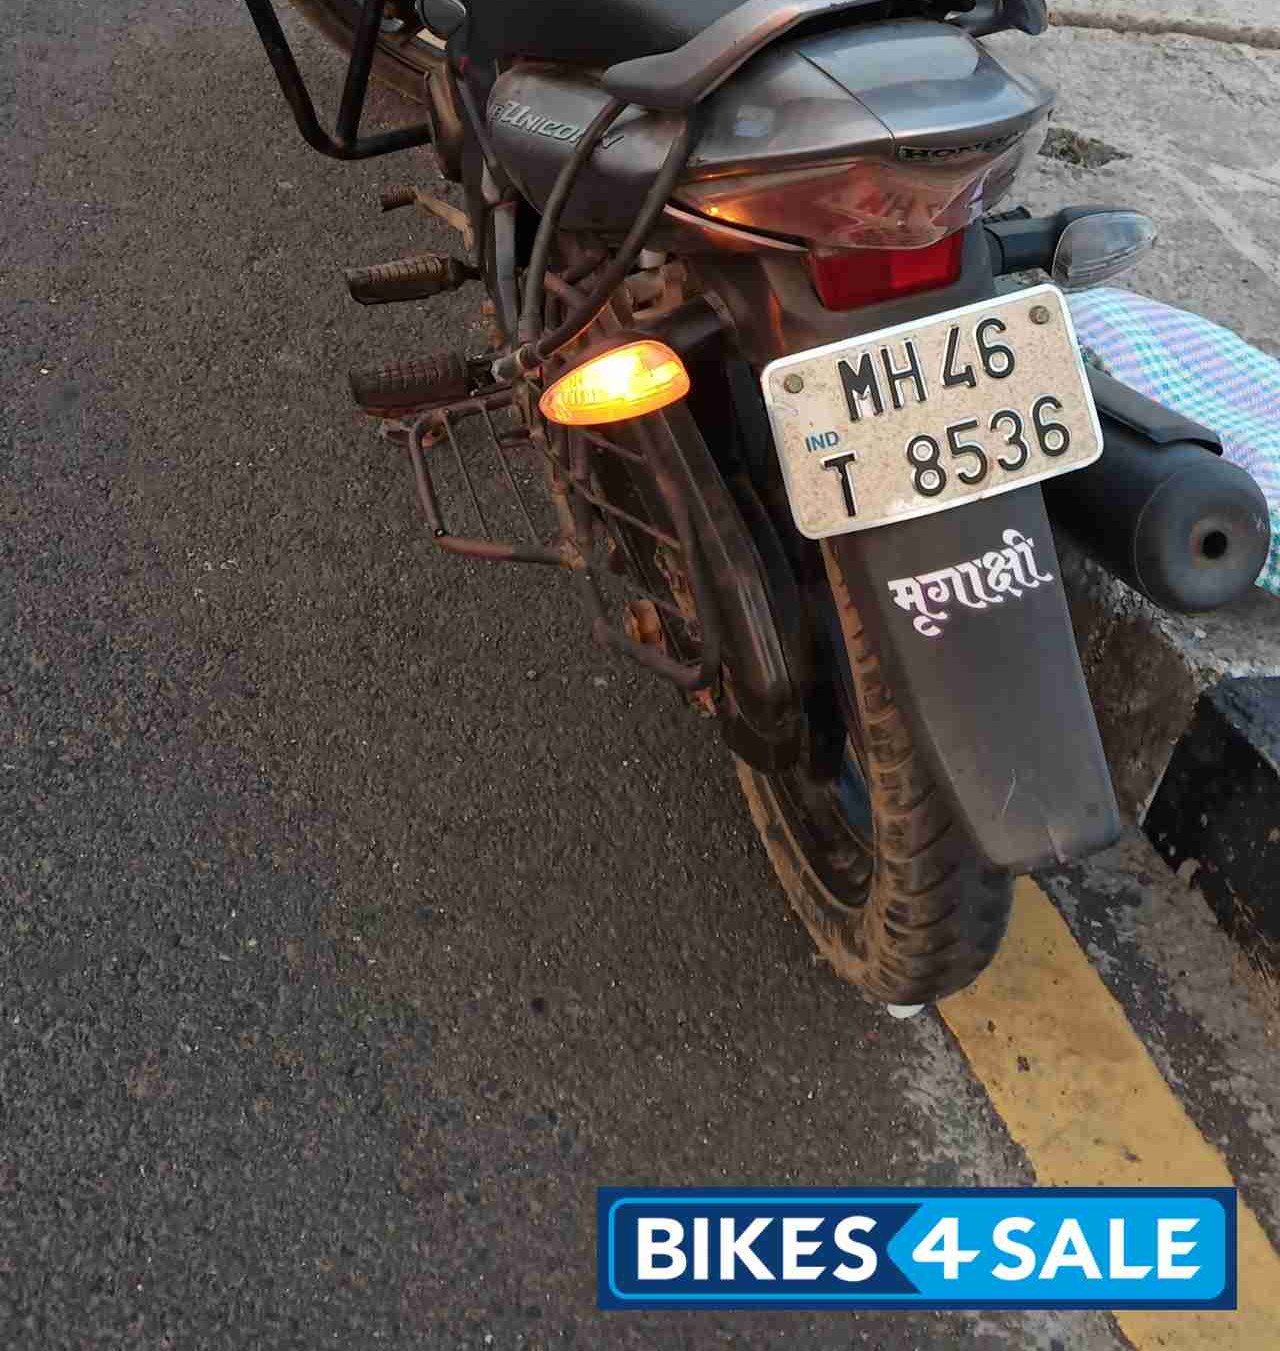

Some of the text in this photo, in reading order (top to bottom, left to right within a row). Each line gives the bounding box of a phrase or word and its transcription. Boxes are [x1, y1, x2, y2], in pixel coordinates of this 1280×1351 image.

[837, 318, 1016, 422] MH 46
[805, 431, 840, 452] IND
[822, 395, 1071, 517] T 8536
